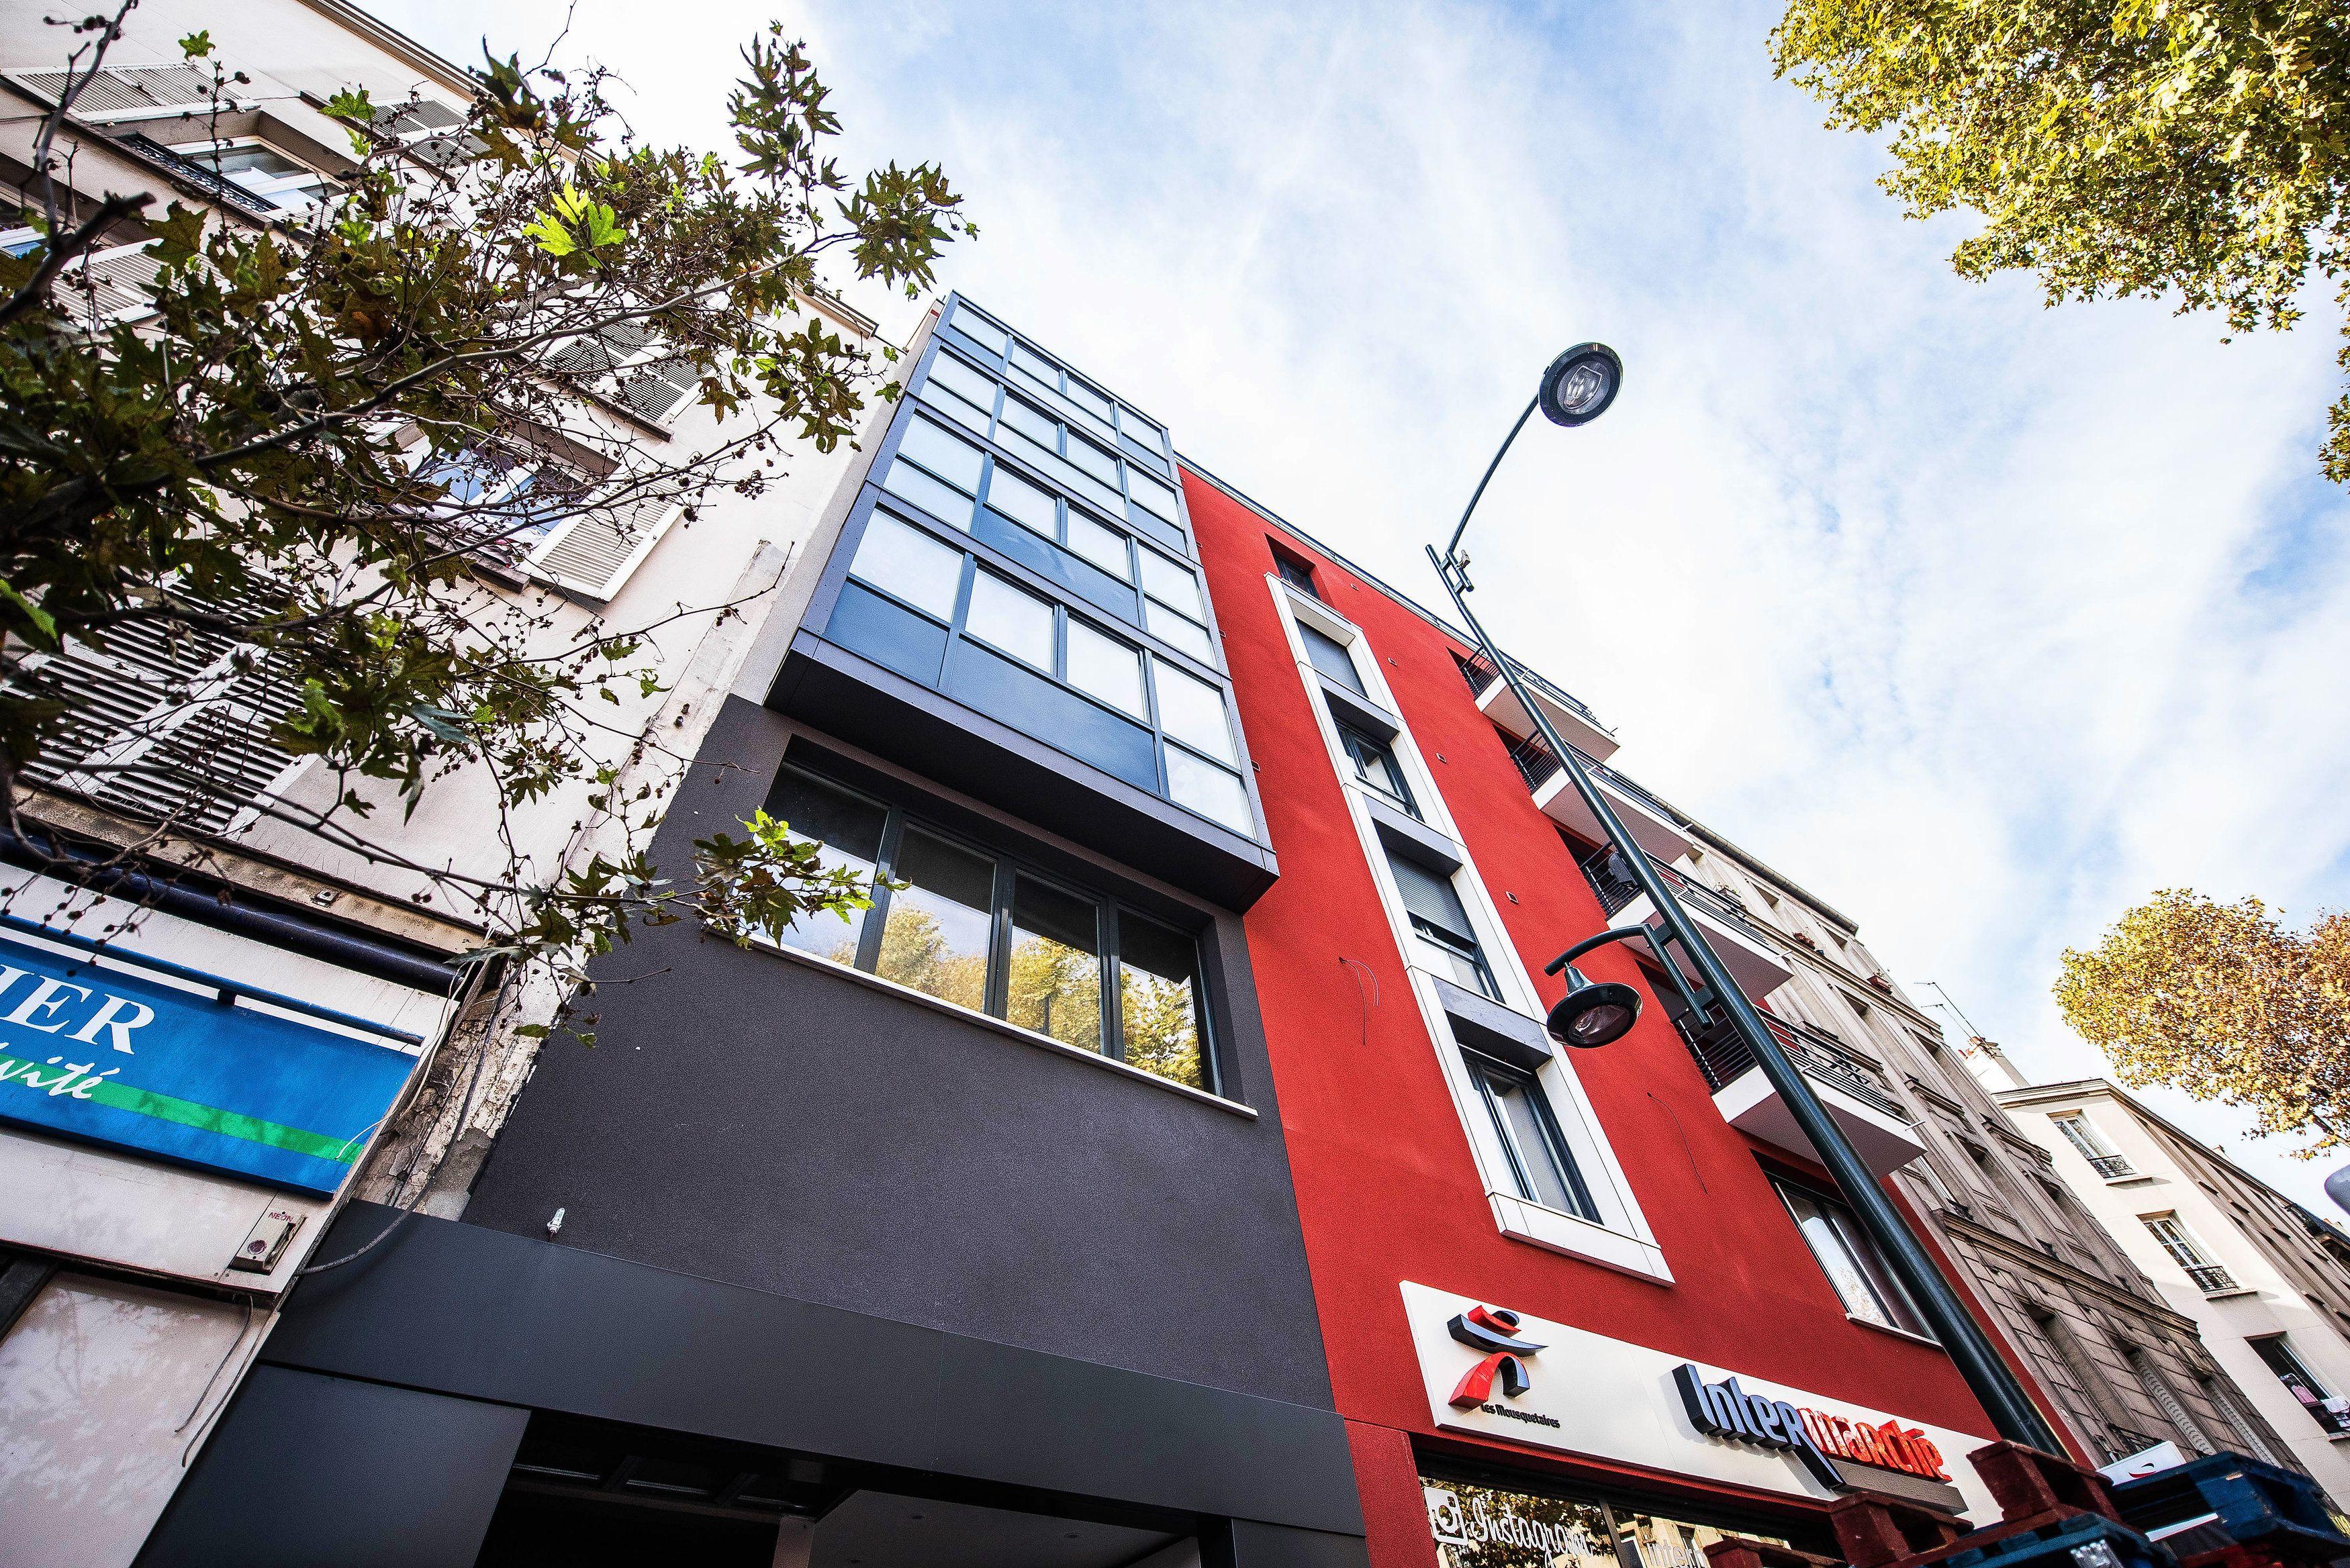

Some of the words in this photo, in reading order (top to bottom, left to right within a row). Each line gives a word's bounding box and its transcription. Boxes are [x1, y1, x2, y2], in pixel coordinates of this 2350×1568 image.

[0, 1042, 121, 1099] vité
[1495, 1404, 1561, 1428] Mousquetaires
[1470, 1497, 1594, 1568] Instagram
